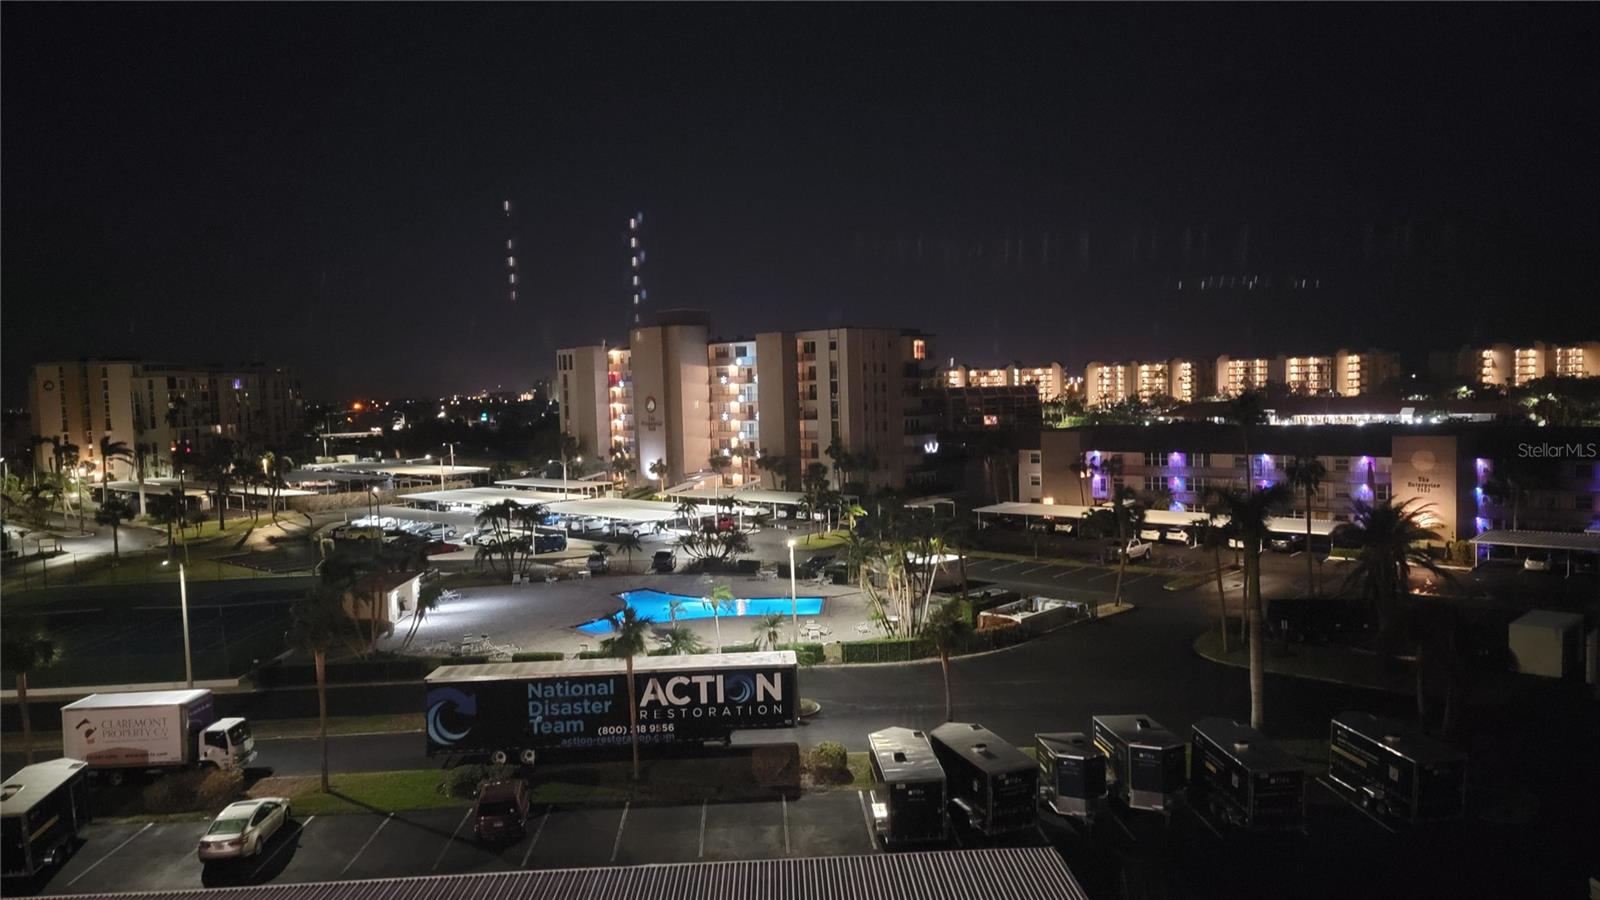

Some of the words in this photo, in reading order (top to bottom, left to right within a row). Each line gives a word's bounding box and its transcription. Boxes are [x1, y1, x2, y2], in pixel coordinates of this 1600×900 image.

[528, 678, 614, 699] National
[639, 672, 782, 707] ACTION
[528, 700, 612, 718] Disaster
[640, 704, 783, 721] RESTORATION
[101, 717, 168, 728] CLAREMONT
[529, 716, 584, 736] Team
[597, 724, 628, 737] (800)
